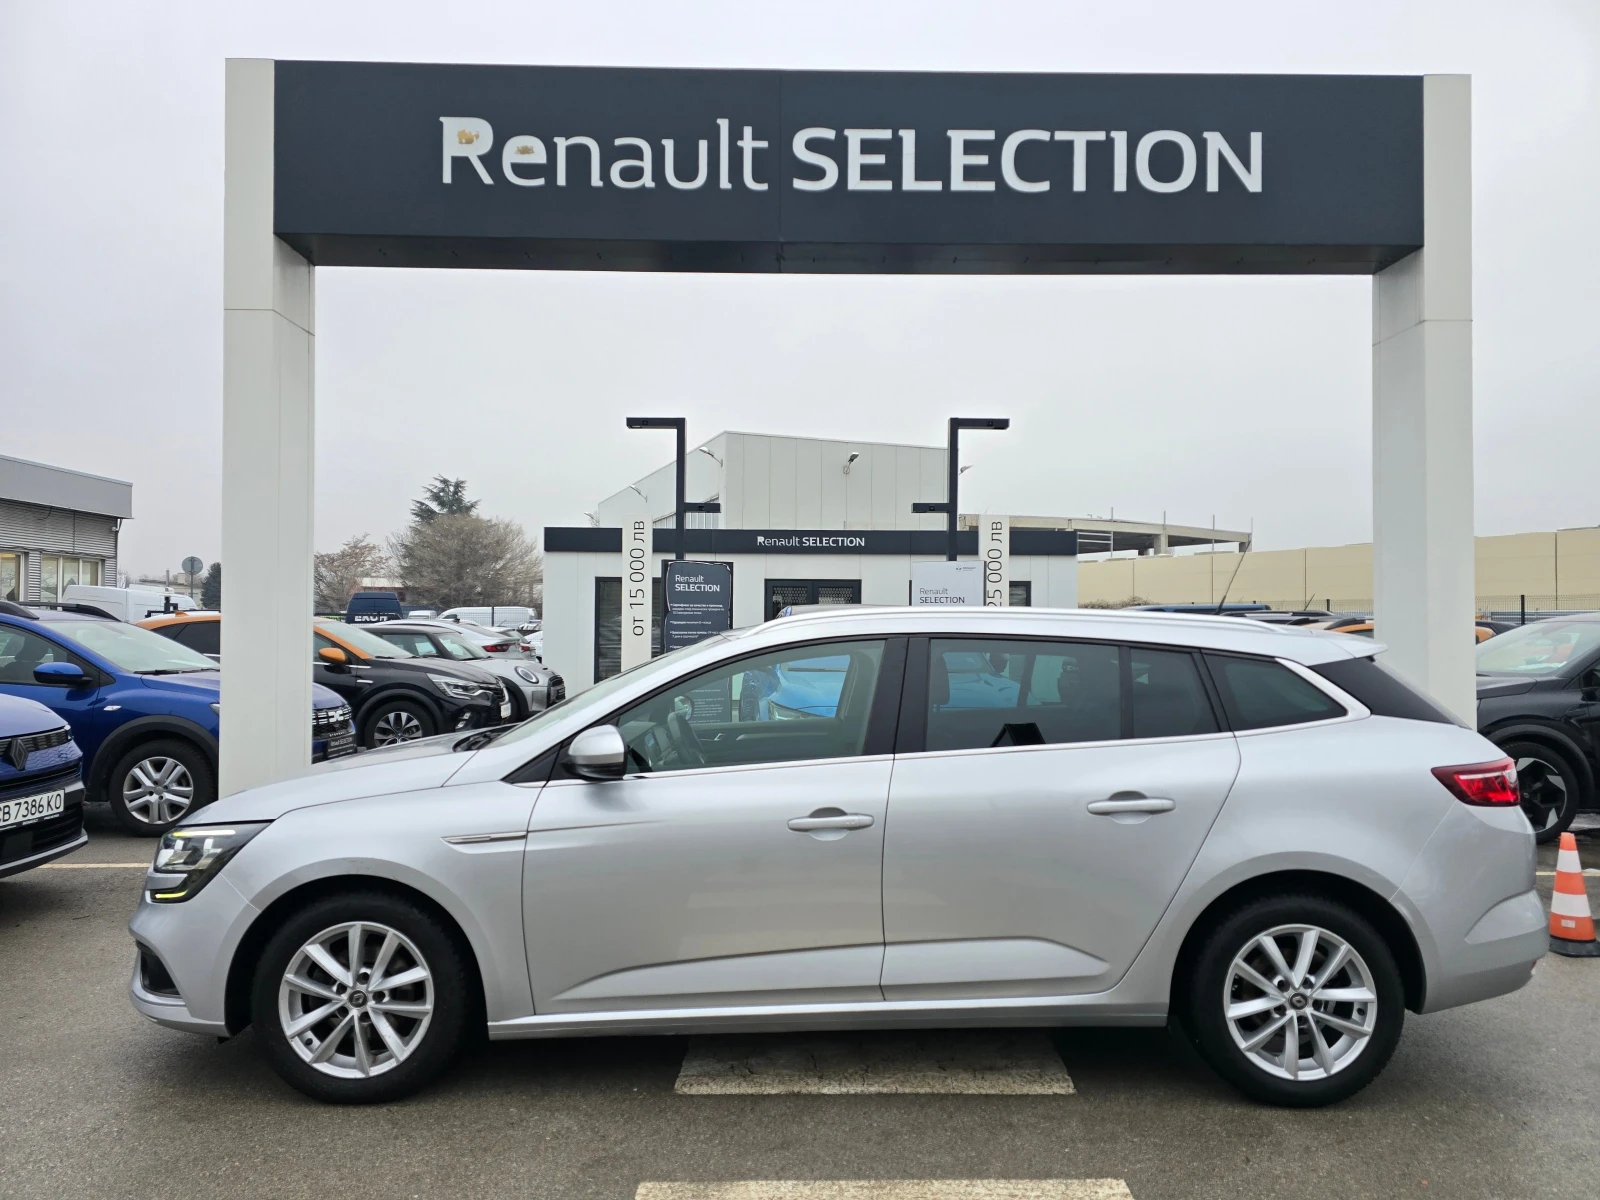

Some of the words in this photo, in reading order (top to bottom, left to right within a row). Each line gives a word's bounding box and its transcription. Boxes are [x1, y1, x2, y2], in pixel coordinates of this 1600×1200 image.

[438, 116, 769, 190] Renault
[791, 126, 1263, 193] SELECTION
[756, 535, 801, 547] Renault
[802, 536, 865, 547] SELECTION
[629, 548, 645, 583] 000
[986, 548, 1003, 584] 000
[675, 574, 705, 583] Renault
[675, 583, 720, 592] SELECTION
[919, 587, 948, 595] Renault
[629, 588, 645, 610] 15
[919, 596, 965, 604] SELECTION
[14, 797, 45, 821] 7386
